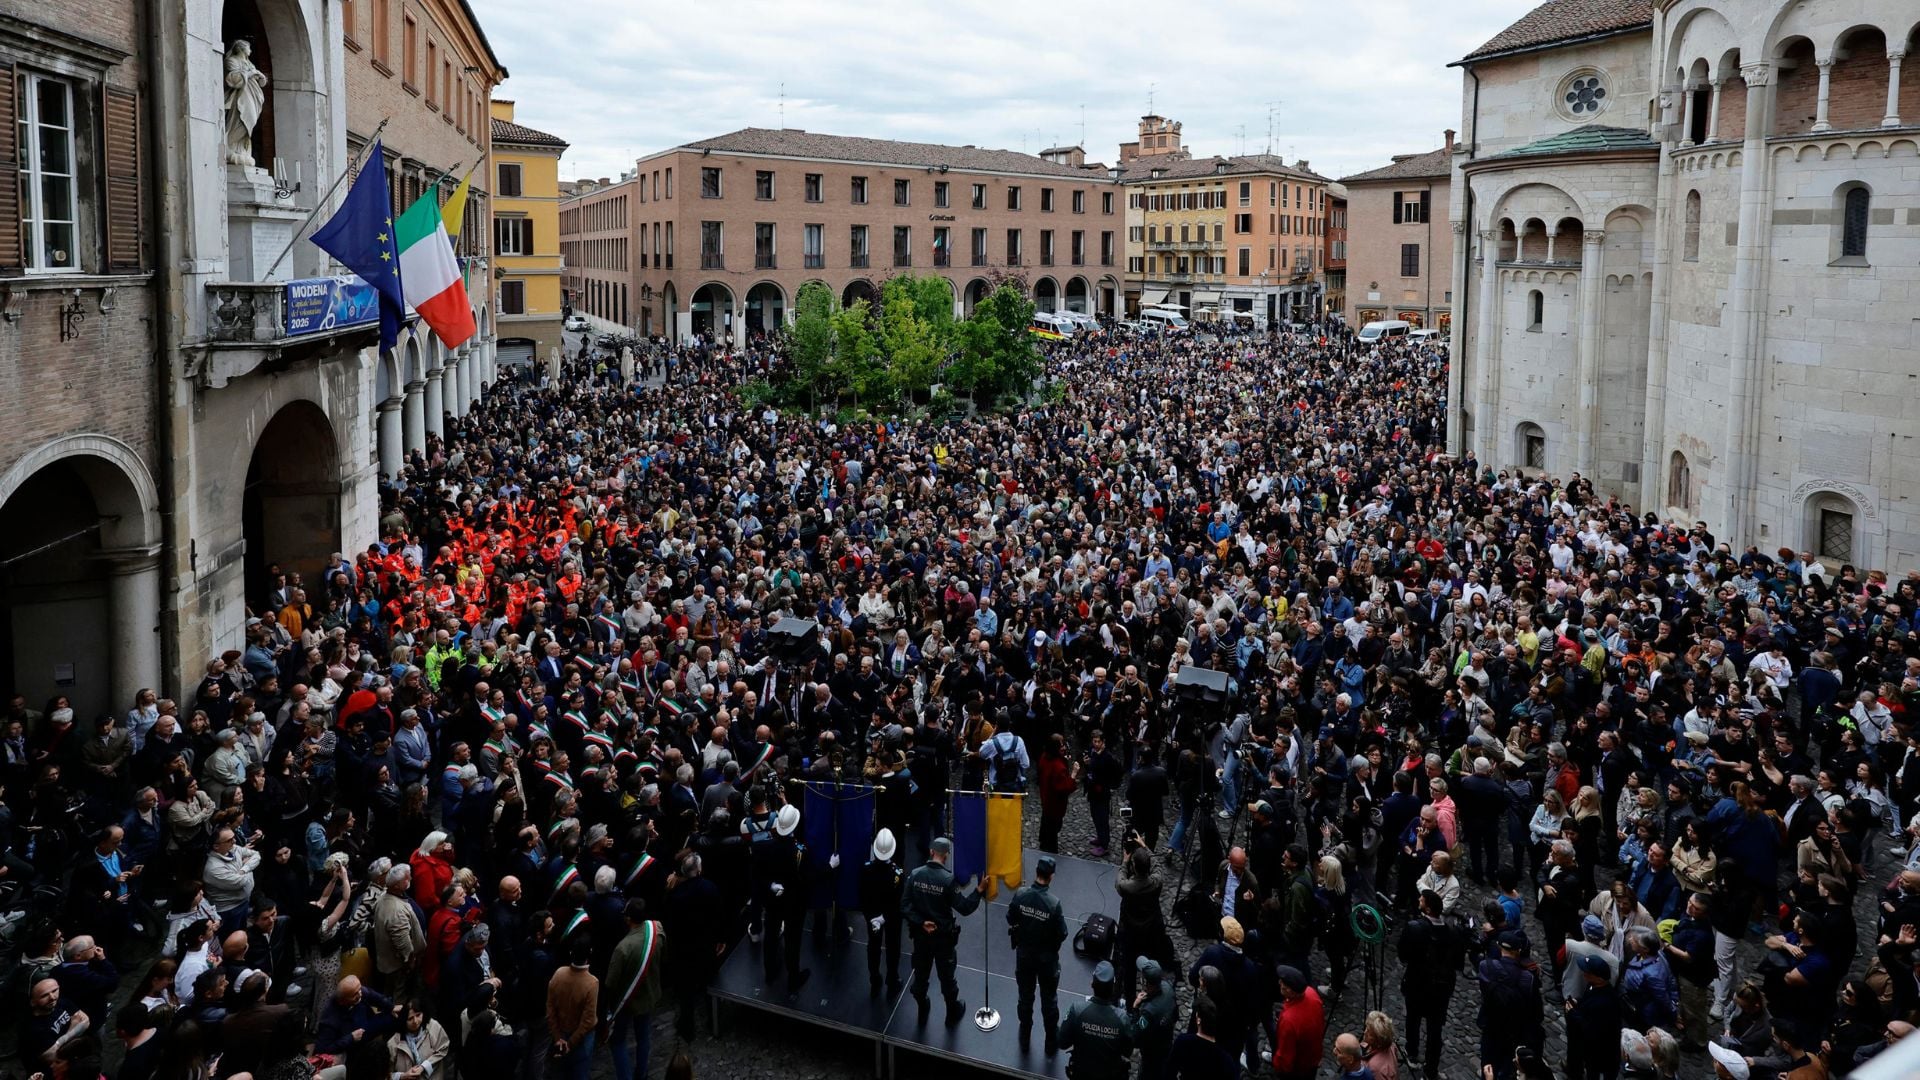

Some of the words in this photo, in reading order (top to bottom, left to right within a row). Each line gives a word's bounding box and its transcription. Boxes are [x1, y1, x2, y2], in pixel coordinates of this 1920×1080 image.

[292, 284, 328, 298] MODENA
[291, 318, 309, 329] 2026
[1019, 904, 1034, 913] POLIZIA
[1035, 910, 1050, 918] LOCALE
[1082, 1022, 1100, 1032] POLIZIA
